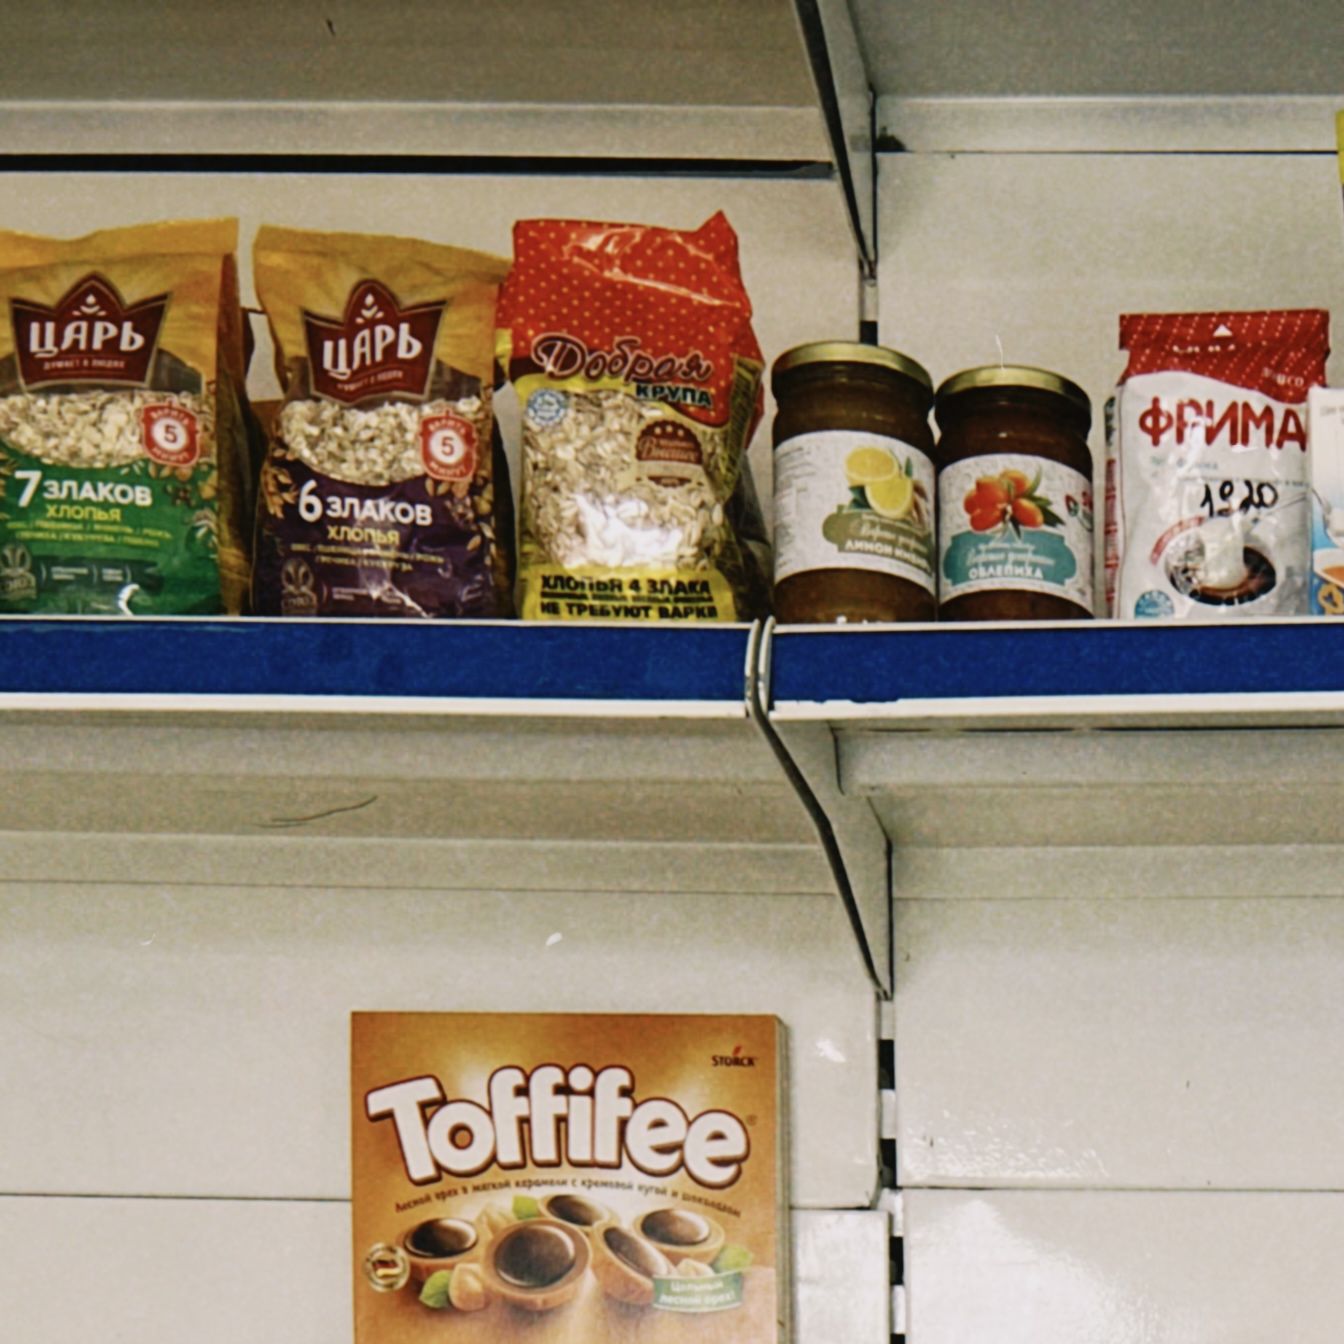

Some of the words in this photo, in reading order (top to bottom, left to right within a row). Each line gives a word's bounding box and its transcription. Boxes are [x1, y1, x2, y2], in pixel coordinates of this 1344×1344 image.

[29, 321, 145, 358] ЦАРЬ
[323, 322, 422, 380] ЦАРЬ
[531, 332, 714, 383] Добрая
[636, 382, 712, 407] КРУПА
[163, 424, 178, 443] 5
[1138, 397, 1307, 452] ФРИМА
[441, 436, 455, 456] 5
[14, 470, 42, 507] 7
[43, 480, 153, 507] ЗЛАКОВ
[46, 504, 122, 522] ХЛОПЬЯ
[299, 479, 323, 523] 6
[326, 495, 433, 526] ЗЛАКОВ
[327, 524, 400, 545] ХЛОПЬЯ
[969, 566, 1044, 579] ОБЛЕПИХА
[541, 574, 624, 593] ХЛОПЬЯ
[630, 576, 642, 593] 4
[647, 577, 711, 595] ЗЛАКА
[541, 602, 561, 617] НЕ
[565, 602, 652, 619] ТРЕБУЮТ
[659, 605, 718, 620] ВАРКИ
[712, 1053, 756, 1068] STORCK
[366, 1064, 750, 1189] Toffifee
